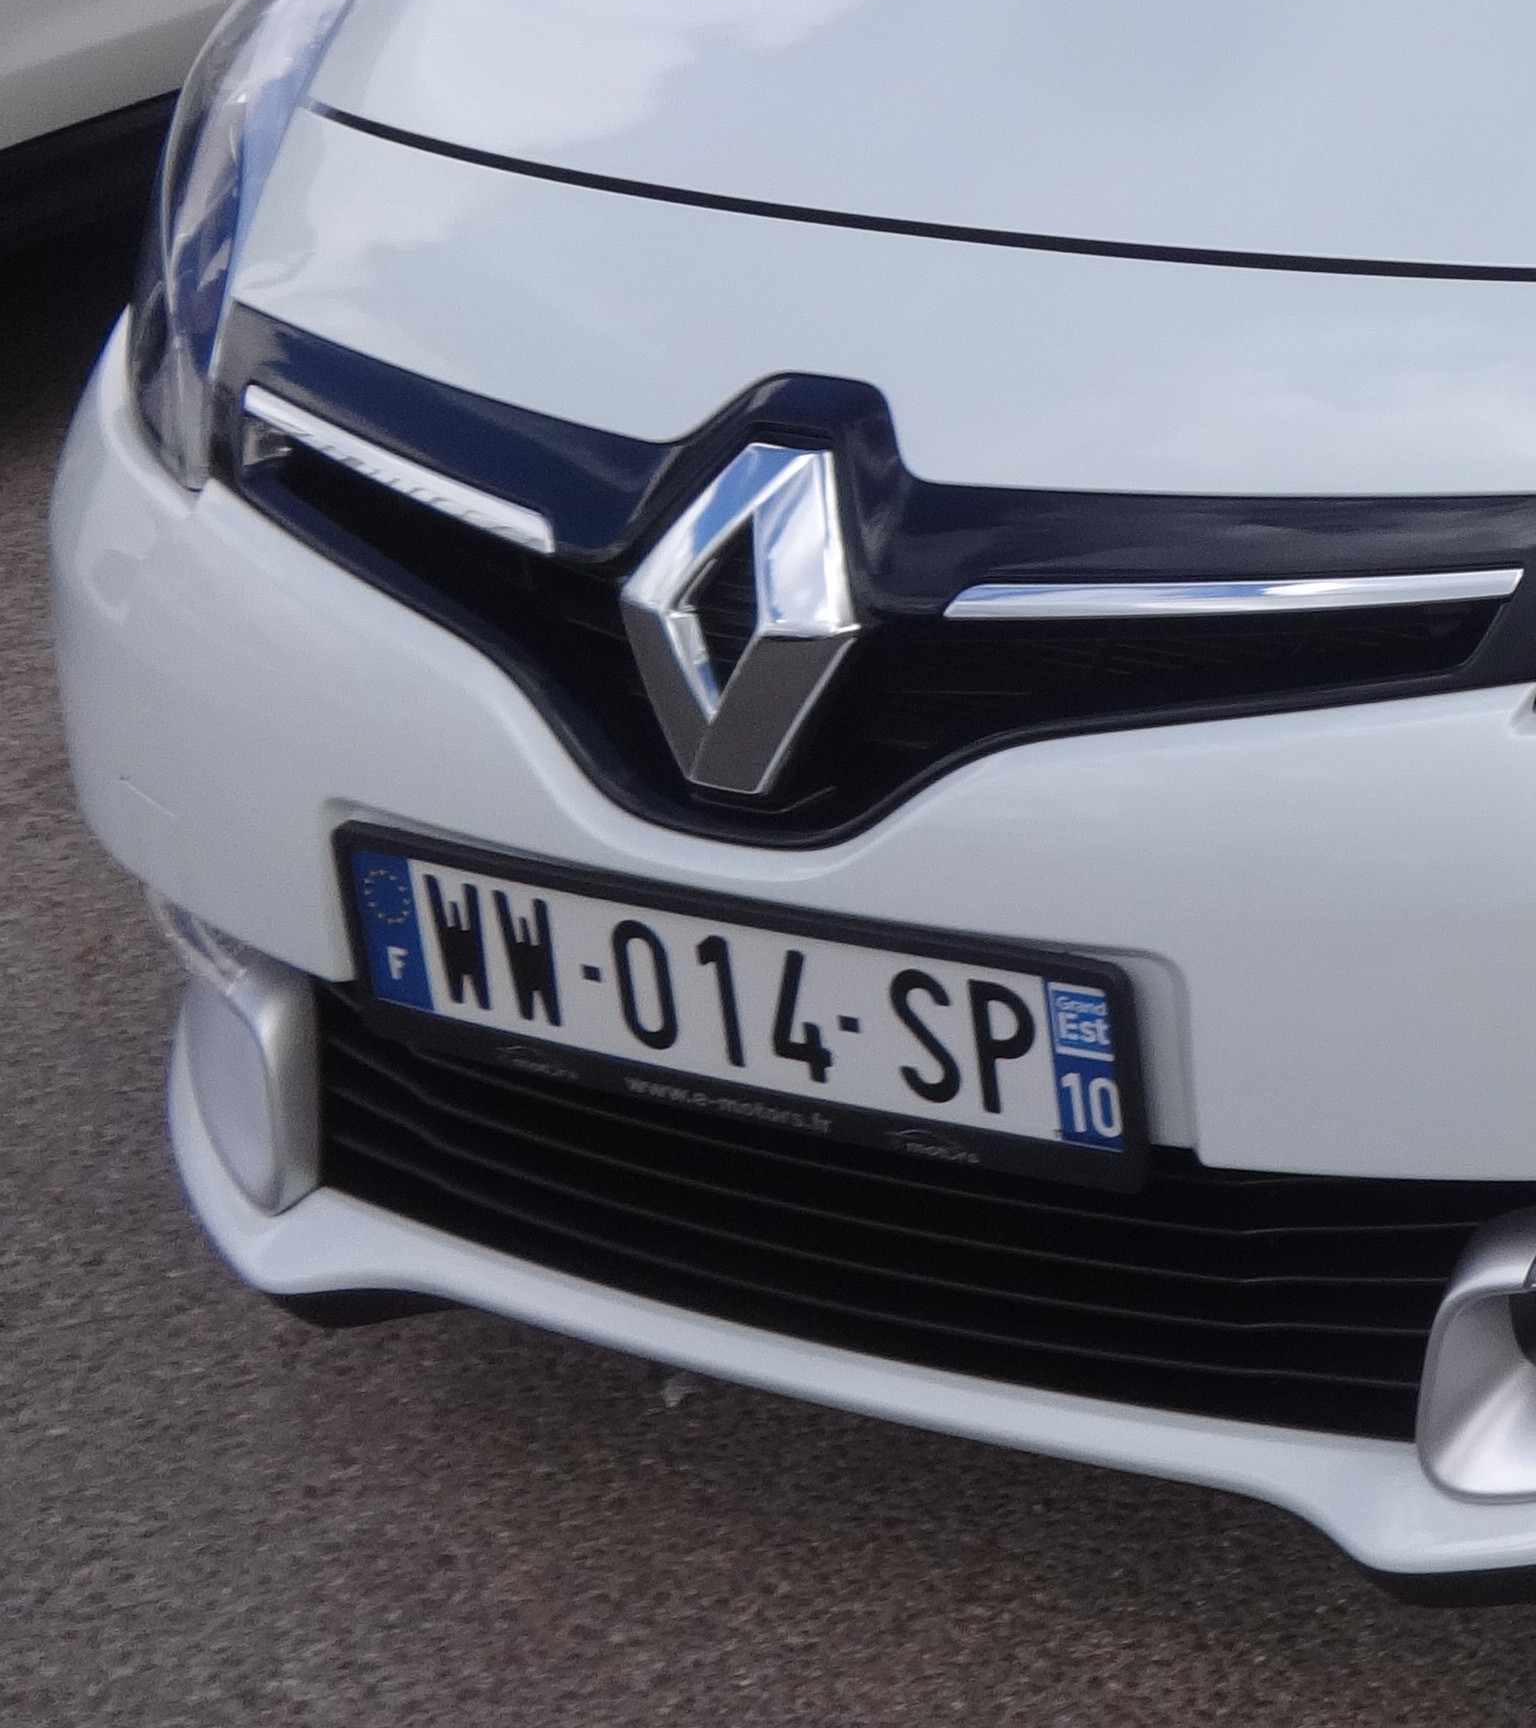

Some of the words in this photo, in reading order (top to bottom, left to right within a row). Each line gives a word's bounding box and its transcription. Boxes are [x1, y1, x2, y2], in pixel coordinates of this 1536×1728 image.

[387, 946, 408, 980] F
[424, 874, 1036, 1114] WW-014-SP
[1058, 1012, 1110, 1045] Est
[1061, 1072, 1124, 1138] 10
